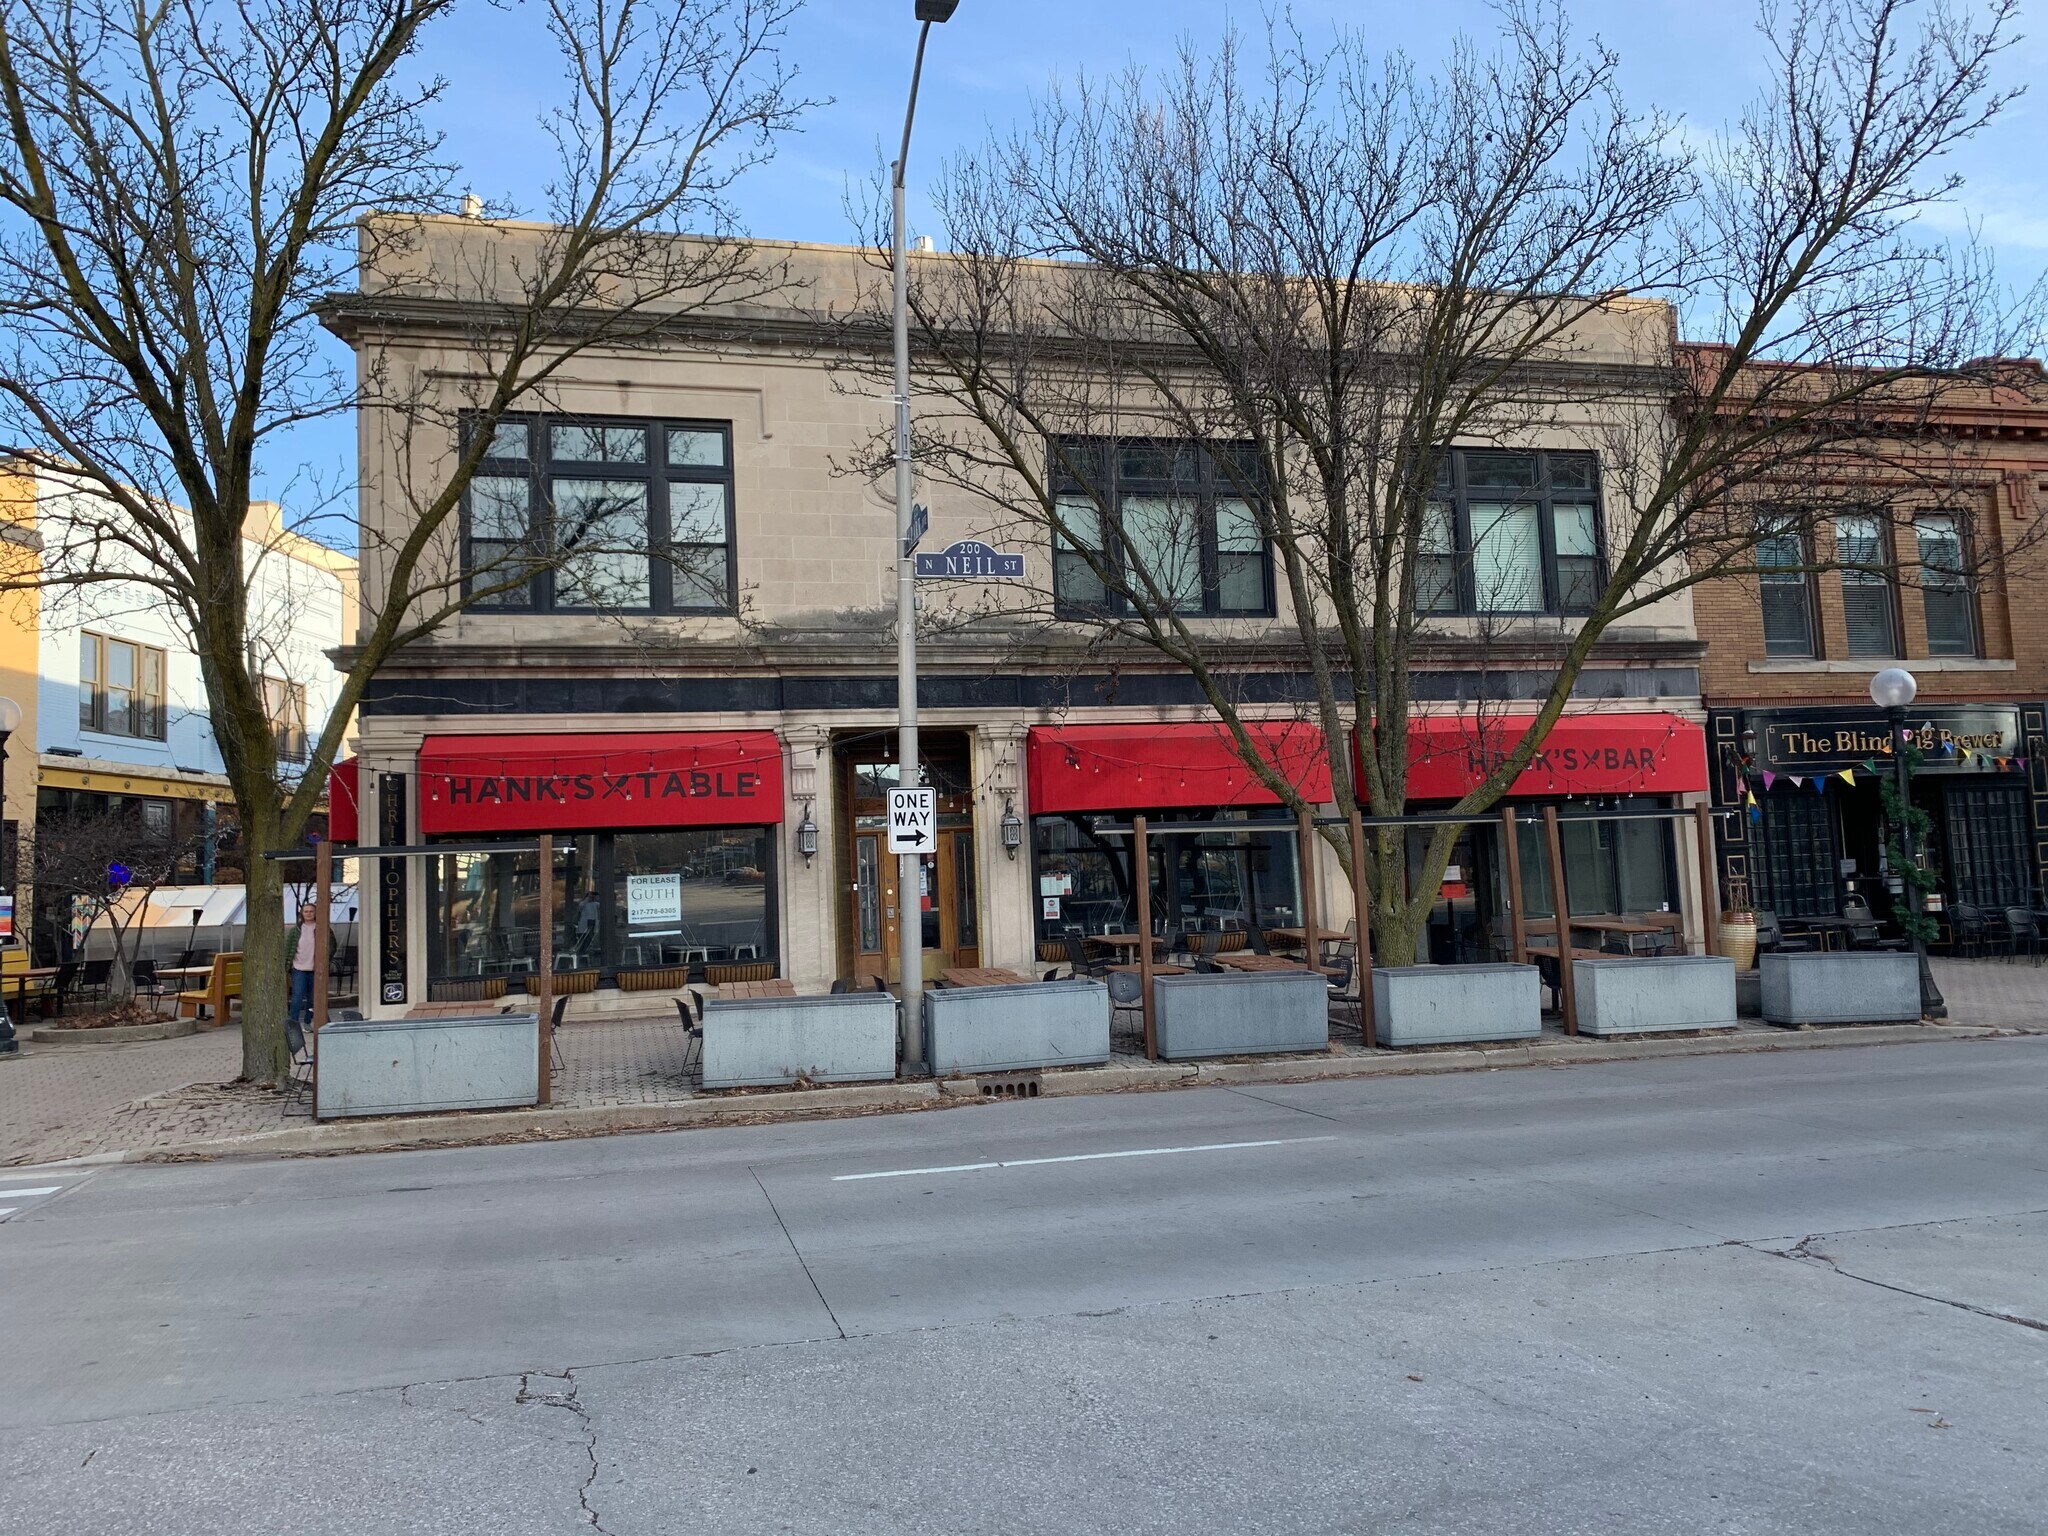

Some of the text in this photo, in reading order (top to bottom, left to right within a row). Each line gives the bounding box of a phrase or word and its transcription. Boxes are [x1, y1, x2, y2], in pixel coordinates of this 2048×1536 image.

[960, 543, 981, 554] 200
[925, 556, 1017, 575] N NEIL ST
[1781, 732, 1832, 754] The
[1834, 729, 1893, 753] Blind
[1604, 747, 1655, 770] BAR
[449, 771, 756, 804] HANK'S TABLE
[894, 793, 929, 809] ONE
[894, 811, 930, 827] WAY
[650, 876, 677, 884] LEASE
